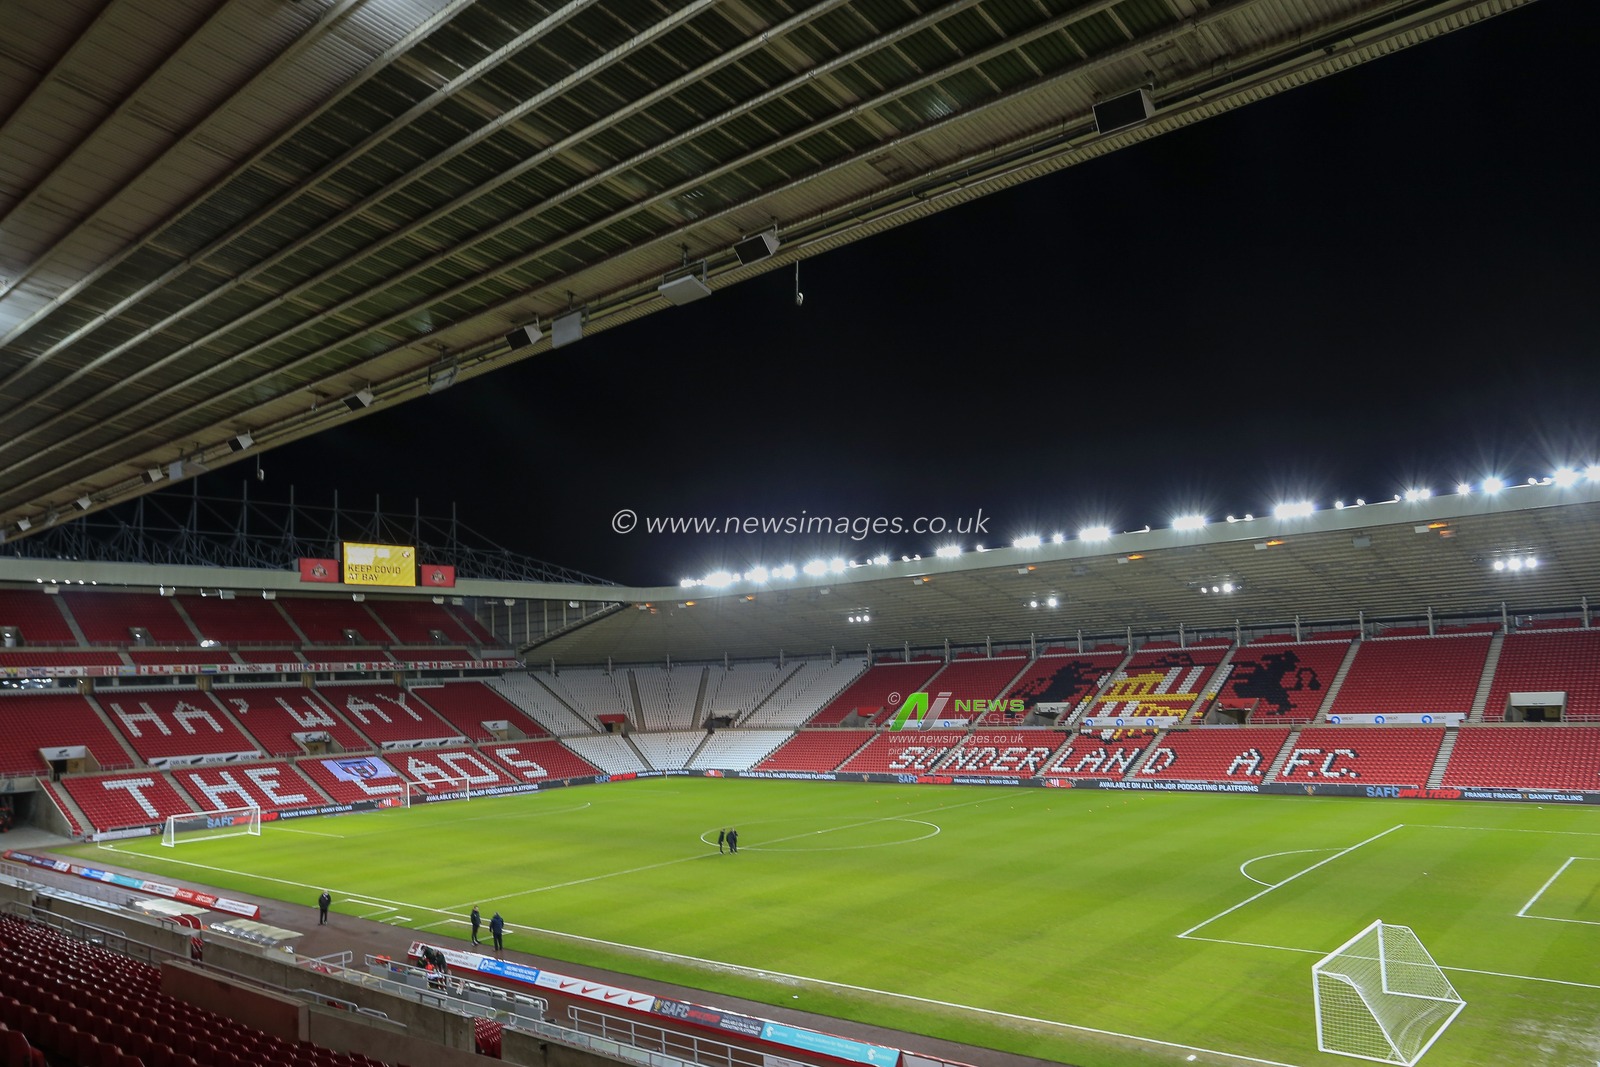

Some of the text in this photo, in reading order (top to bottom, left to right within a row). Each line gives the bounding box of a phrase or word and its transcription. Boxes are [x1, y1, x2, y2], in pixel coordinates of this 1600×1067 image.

[348, 565, 401, 574] KEEP COVID
[888, 746, 1176, 775] SUNDERLAND
[102, 767, 308, 819] THE
[1099, 781, 1131, 789] AVAILABLE
[1153, 783, 1176, 791] MAJOR
[1177, 783, 1218, 792] PODCASTING
[1218, 785, 1259, 793] PLATFORMS
[1366, 786, 1399, 798] SAFC
[1464, 791, 1493, 799] FRANKIE
[1493, 792, 1522, 800] FRANCIS
[1528, 793, 1552, 801] DANNY
[1553, 794, 1584, 802] COLLINS
[207, 816, 234, 829] SAFC
[662, 1000, 691, 1019] SAFC
